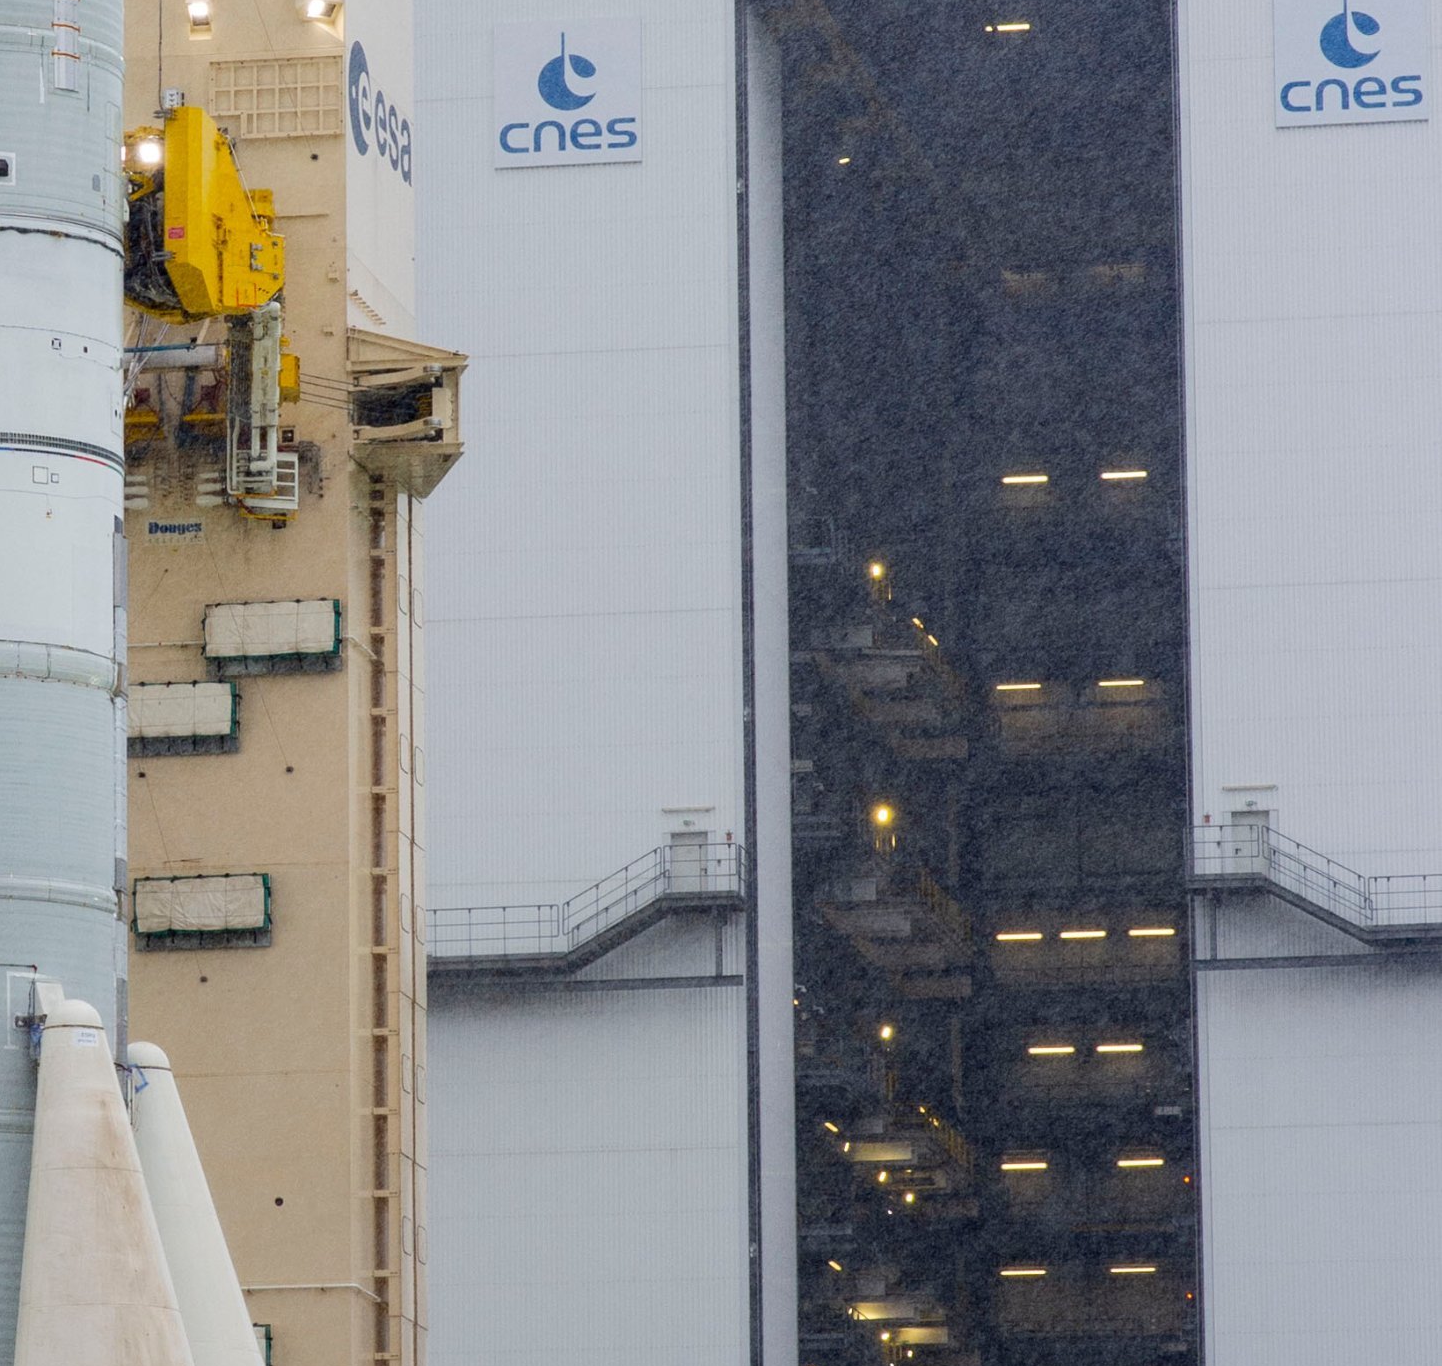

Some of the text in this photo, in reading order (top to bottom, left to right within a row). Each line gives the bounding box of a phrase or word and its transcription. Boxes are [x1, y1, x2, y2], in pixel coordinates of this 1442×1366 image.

[1279, 73, 1424, 114] cnes
[375, 89, 413, 188] esa
[498, 114, 639, 155] cnes
